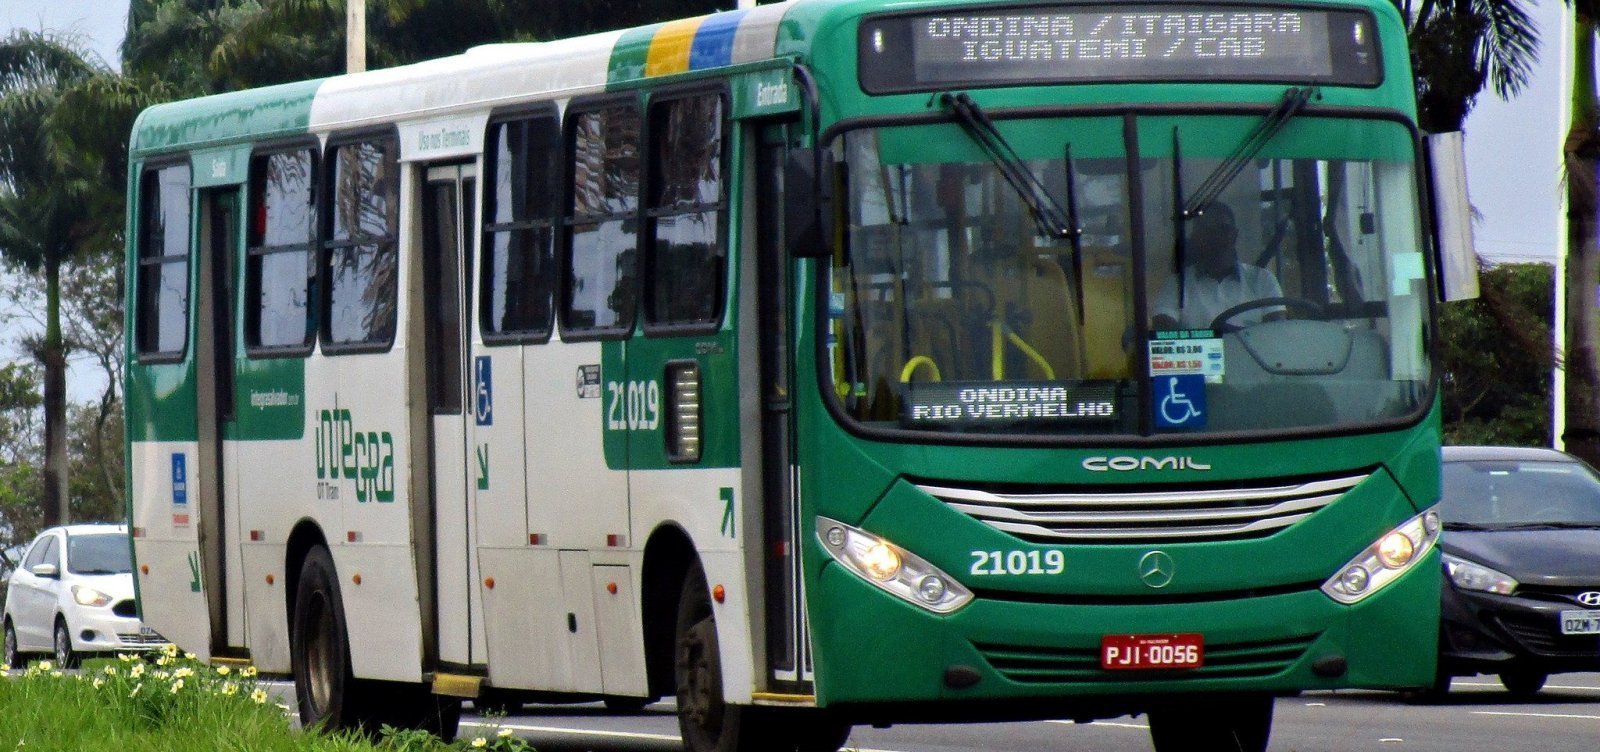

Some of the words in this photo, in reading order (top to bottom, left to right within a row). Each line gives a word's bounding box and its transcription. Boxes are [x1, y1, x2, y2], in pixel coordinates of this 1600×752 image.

[928, 16, 1073, 38] ONDINA
[1121, 13, 1301, 35] ITAIGARA
[963, 39, 1147, 60] IGUATEMI
[1196, 36, 1265, 57] CAB
[608, 380, 659, 430] 21019
[959, 387, 1068, 402] ONDINA
[913, 404, 962, 419] RIO
[966, 402, 1114, 418] VERMELHO
[1081, 456, 1212, 472] COMIL
[970, 550, 1065, 575] 21019
